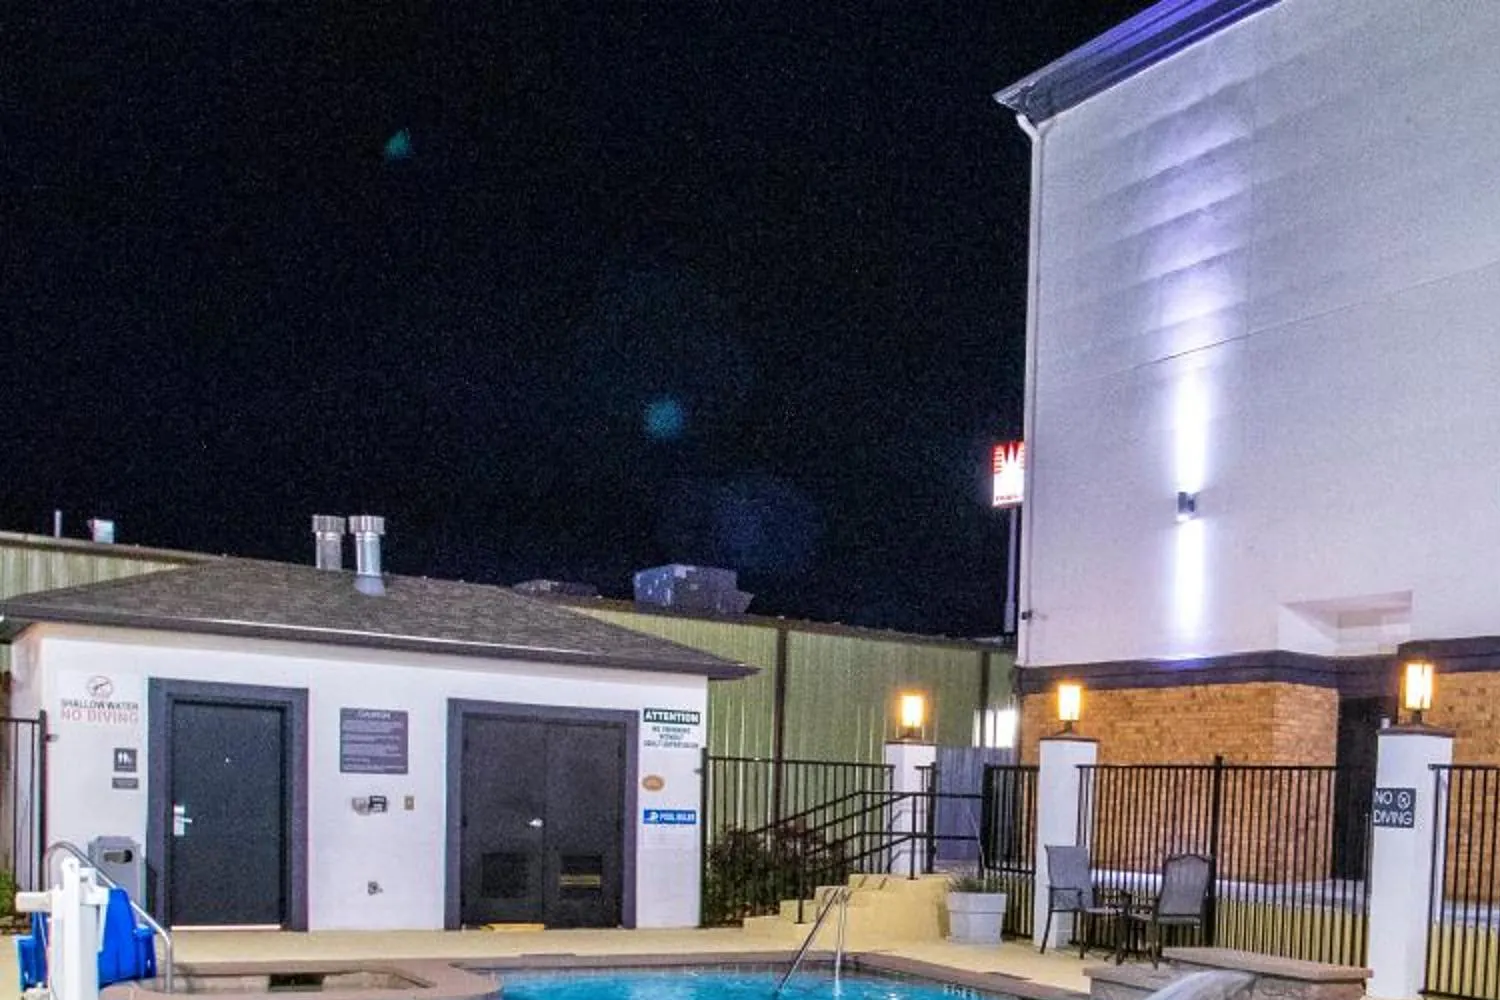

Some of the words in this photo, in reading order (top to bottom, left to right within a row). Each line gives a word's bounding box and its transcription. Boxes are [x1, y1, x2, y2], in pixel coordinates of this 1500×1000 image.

[61, 698, 104, 709] SHALLOW
[107, 702, 138, 711] WATER
[61, 707, 81, 721] NO
[87, 709, 139, 724] DIVING
[645, 711, 699, 724] ATTENTION
[1374, 790, 1393, 805] NO
[1373, 809, 1413, 825] DIVING
